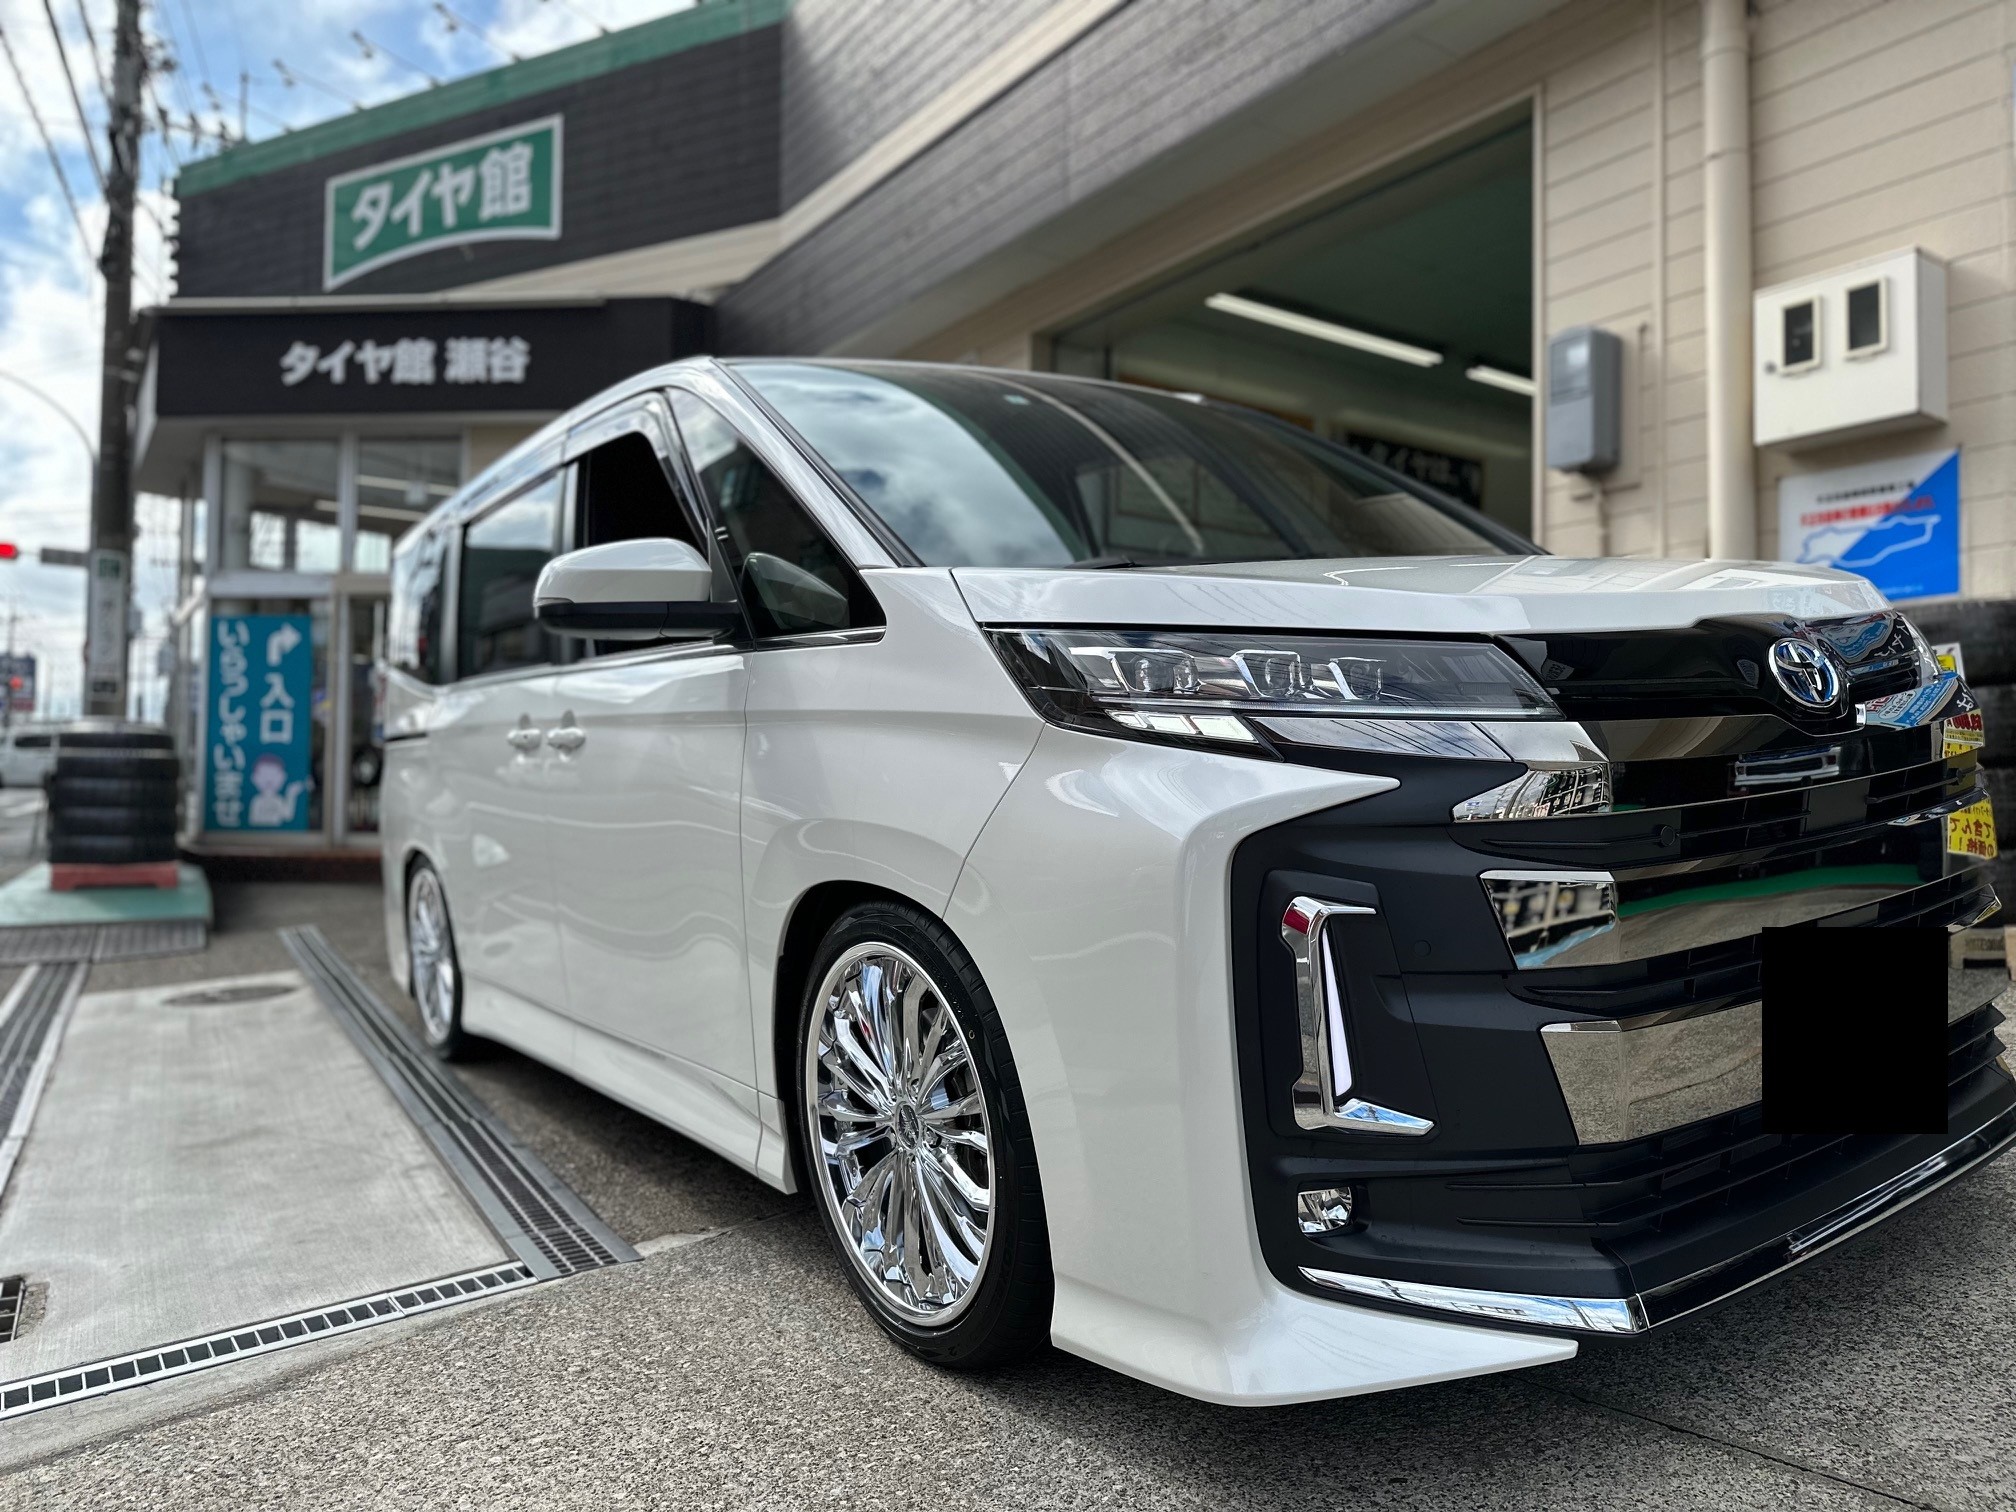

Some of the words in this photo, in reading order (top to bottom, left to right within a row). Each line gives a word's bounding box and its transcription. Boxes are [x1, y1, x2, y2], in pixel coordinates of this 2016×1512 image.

[351, 141, 534, 249] タイヤ館
[279, 338, 437, 386] タイヤ館
[444, 336, 530, 384] 瀬谷
[213, 619, 250, 828] いらっしゃいませ
[260, 671, 295, 745] 入口
